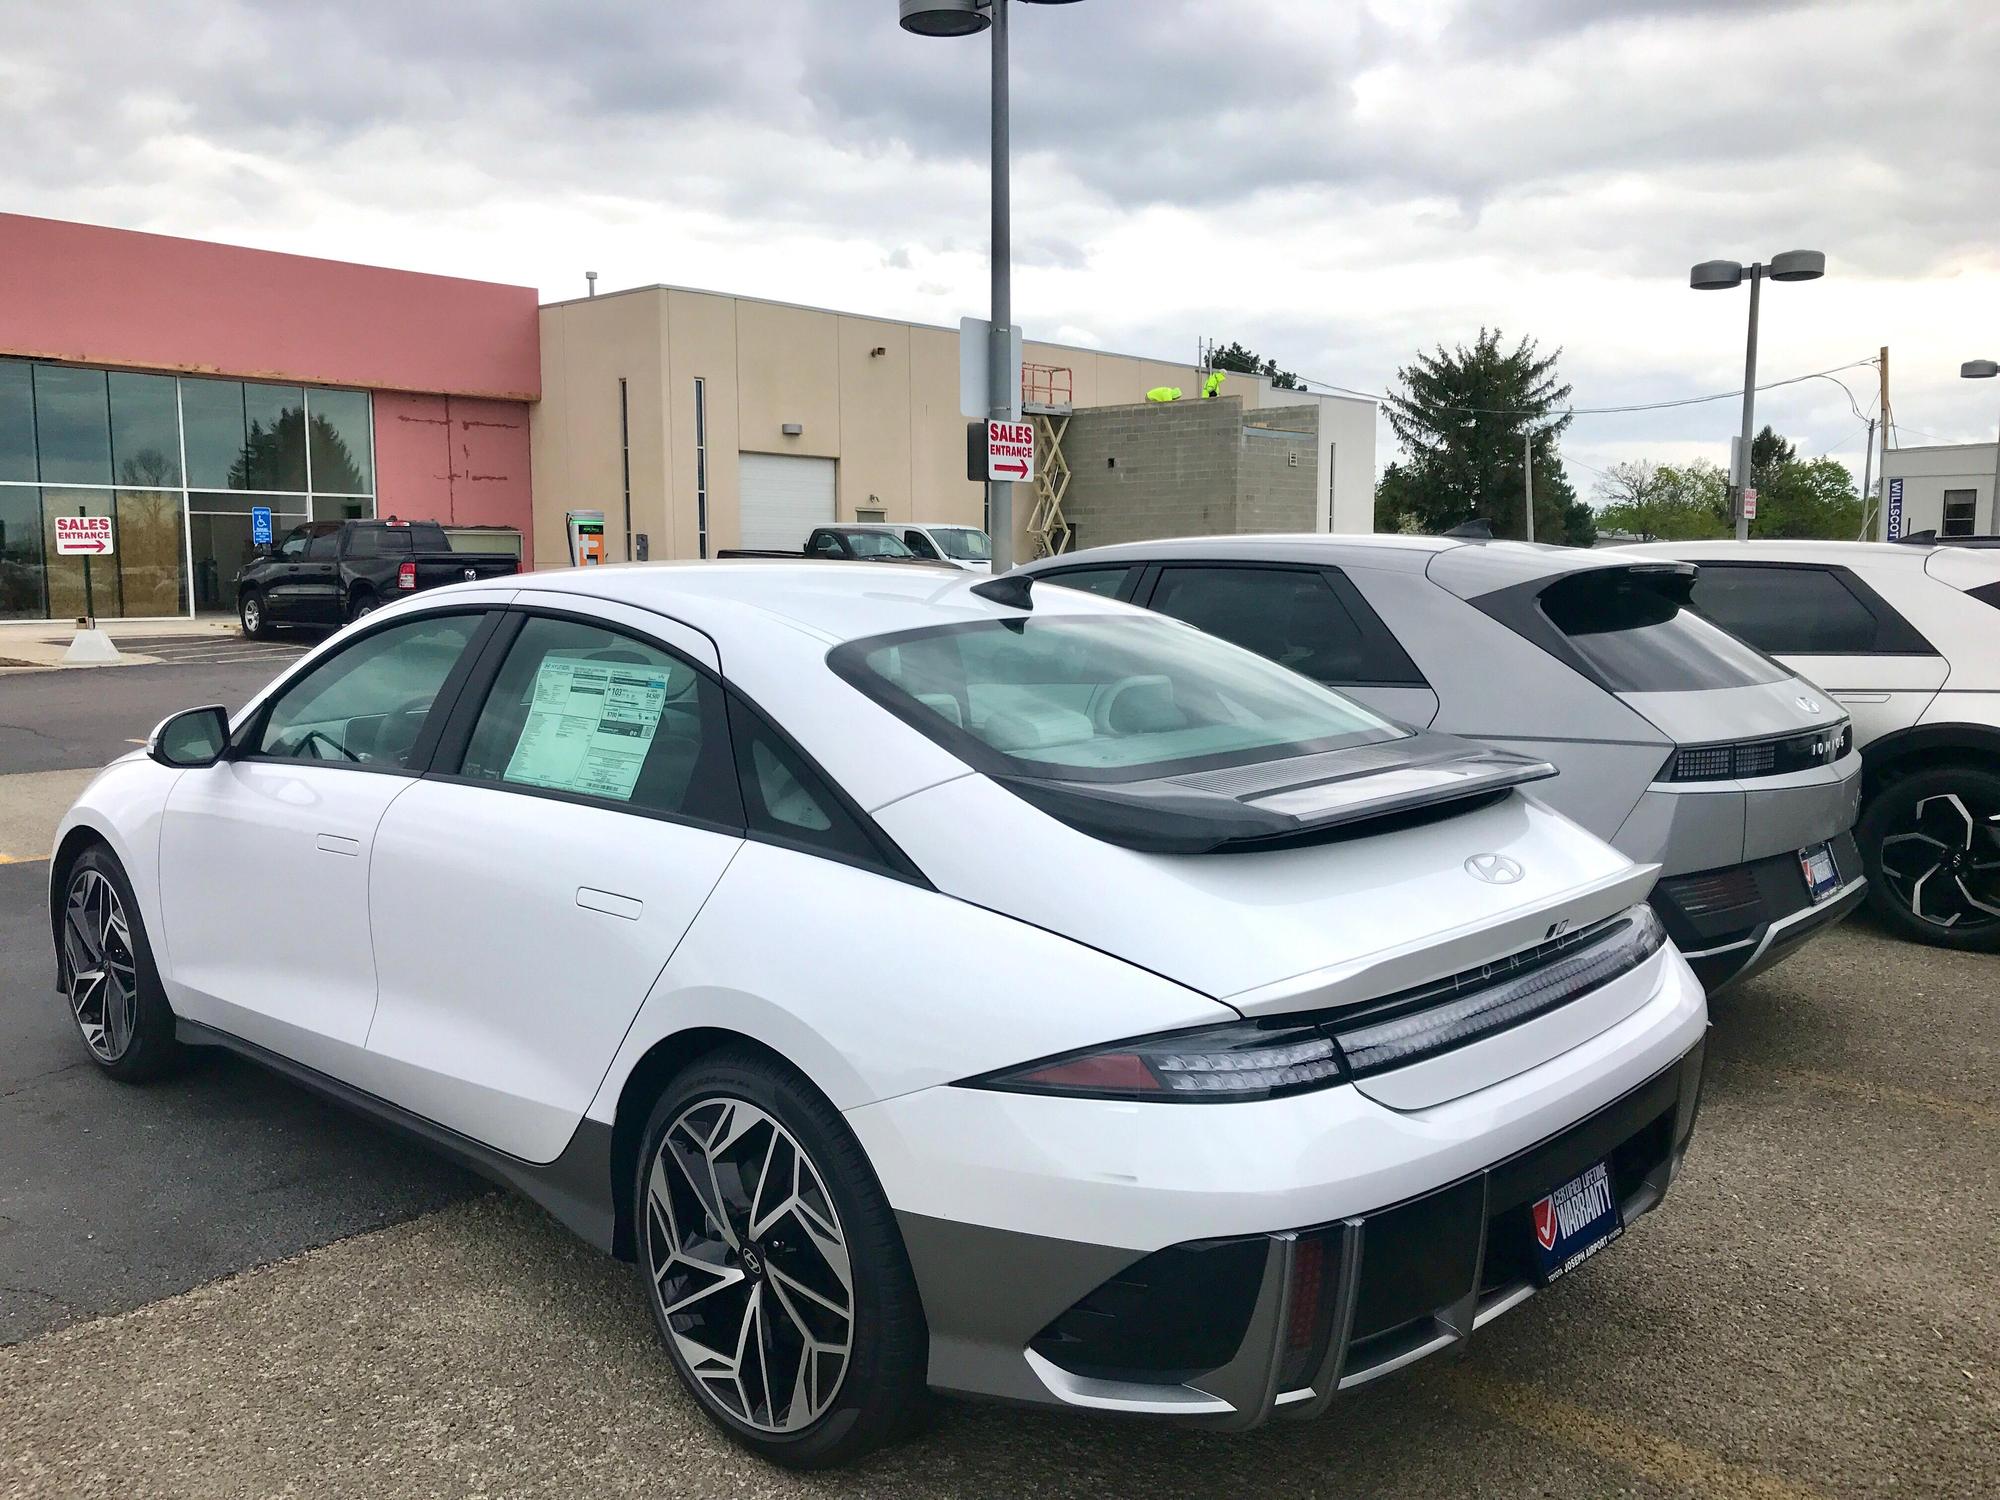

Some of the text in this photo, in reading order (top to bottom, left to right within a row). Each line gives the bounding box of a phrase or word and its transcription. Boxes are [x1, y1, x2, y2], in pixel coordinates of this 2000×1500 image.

[990, 423, 1032, 444] SALES
[990, 444, 1032, 458] ENTRANCE
[57, 518, 109, 530] SALES
[1889, 481, 1901, 539] WILLSCOT
[58, 531, 110, 539] ENTRANCE
[1553, 1161, 1608, 1206] CERTIFIED LIFETIME
[1556, 1175, 1612, 1240] WARRANTY
[1564, 1251, 1586, 1273] JOSEPH
[1585, 1235, 1608, 1259] AIRPORT
